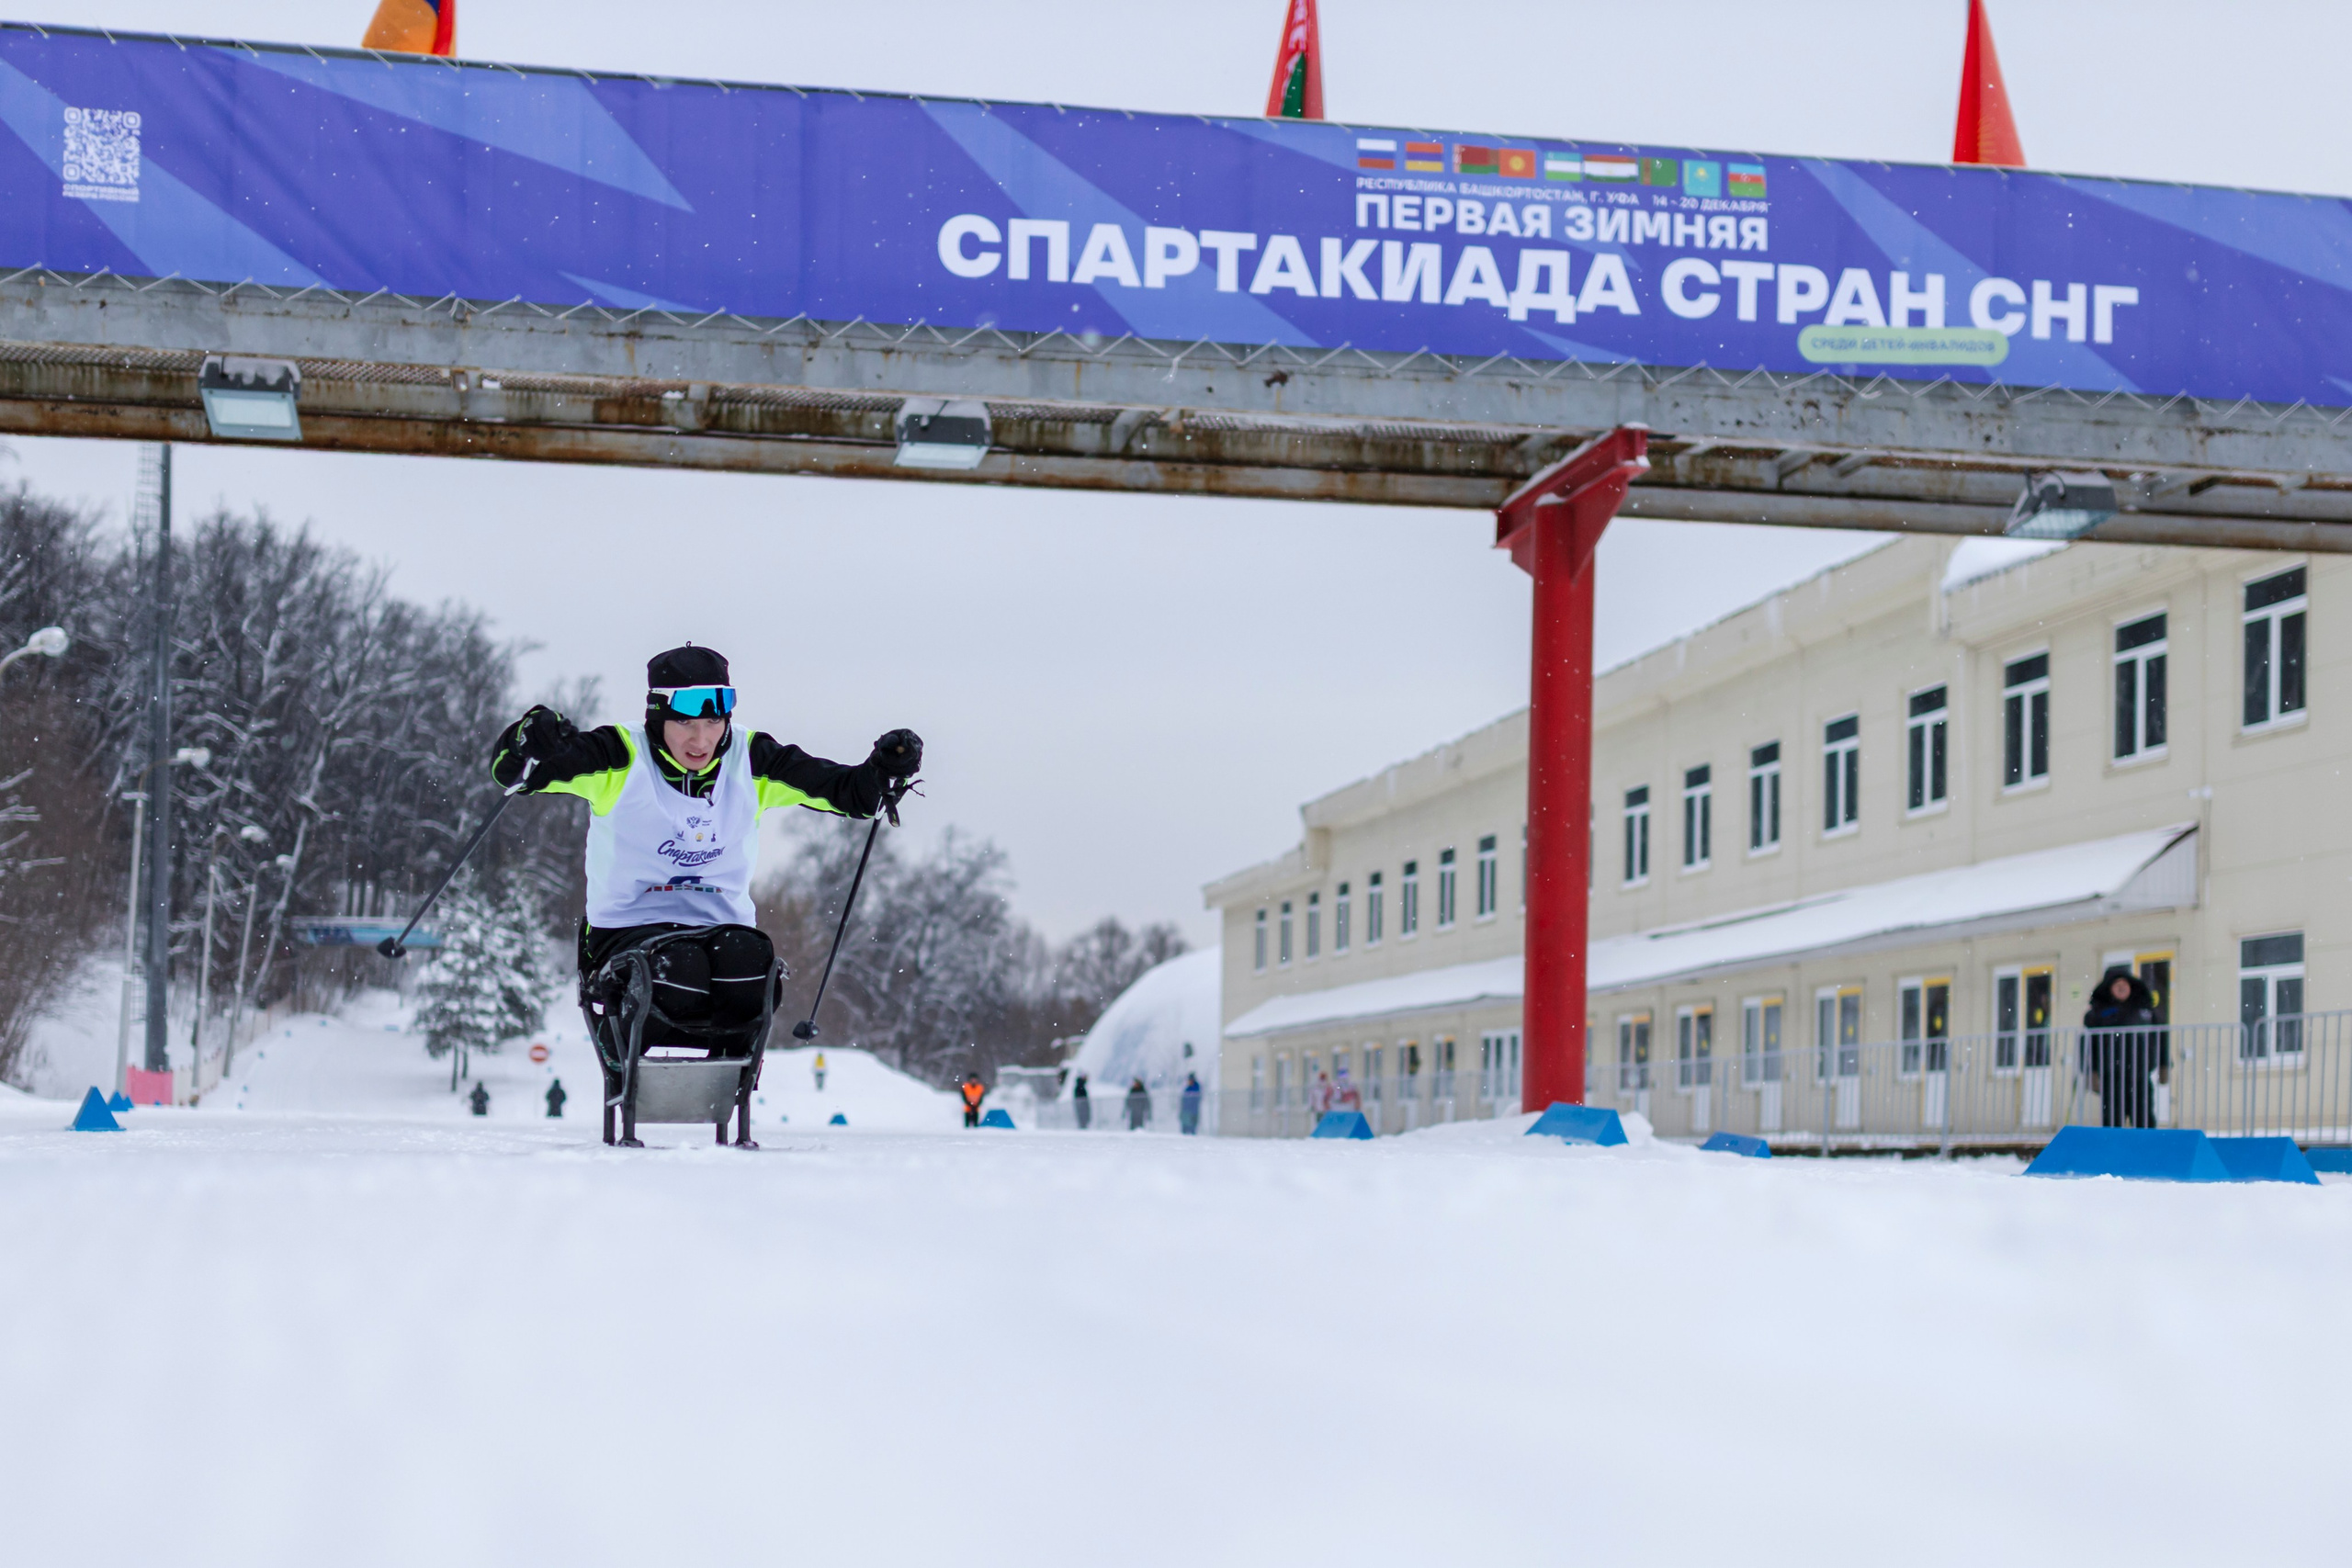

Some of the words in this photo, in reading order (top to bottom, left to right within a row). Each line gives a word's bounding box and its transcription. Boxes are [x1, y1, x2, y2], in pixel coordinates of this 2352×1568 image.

[1356, 176, 1456, 194] РЕСПУБЛИКА
[1459, 182, 1588, 204] БАШКОРТОСТАН,
[1606, 191, 1639, 206] УФА
[1679, 197, 1698, 209] 20
[1701, 198, 1769, 213] ДЕКАБРЯ
[1355, 193, 1552, 239] ПЕРВАЯ
[1564, 205, 1769, 251] ЗИМНЯЯ
[937, 213, 1642, 323] СПАРТАКИАДА
[1660, 256, 1946, 329] СТРАН
[1969, 276, 2139, 344] СНГ
[1811, 336, 1858, 351] СРЕДИ
